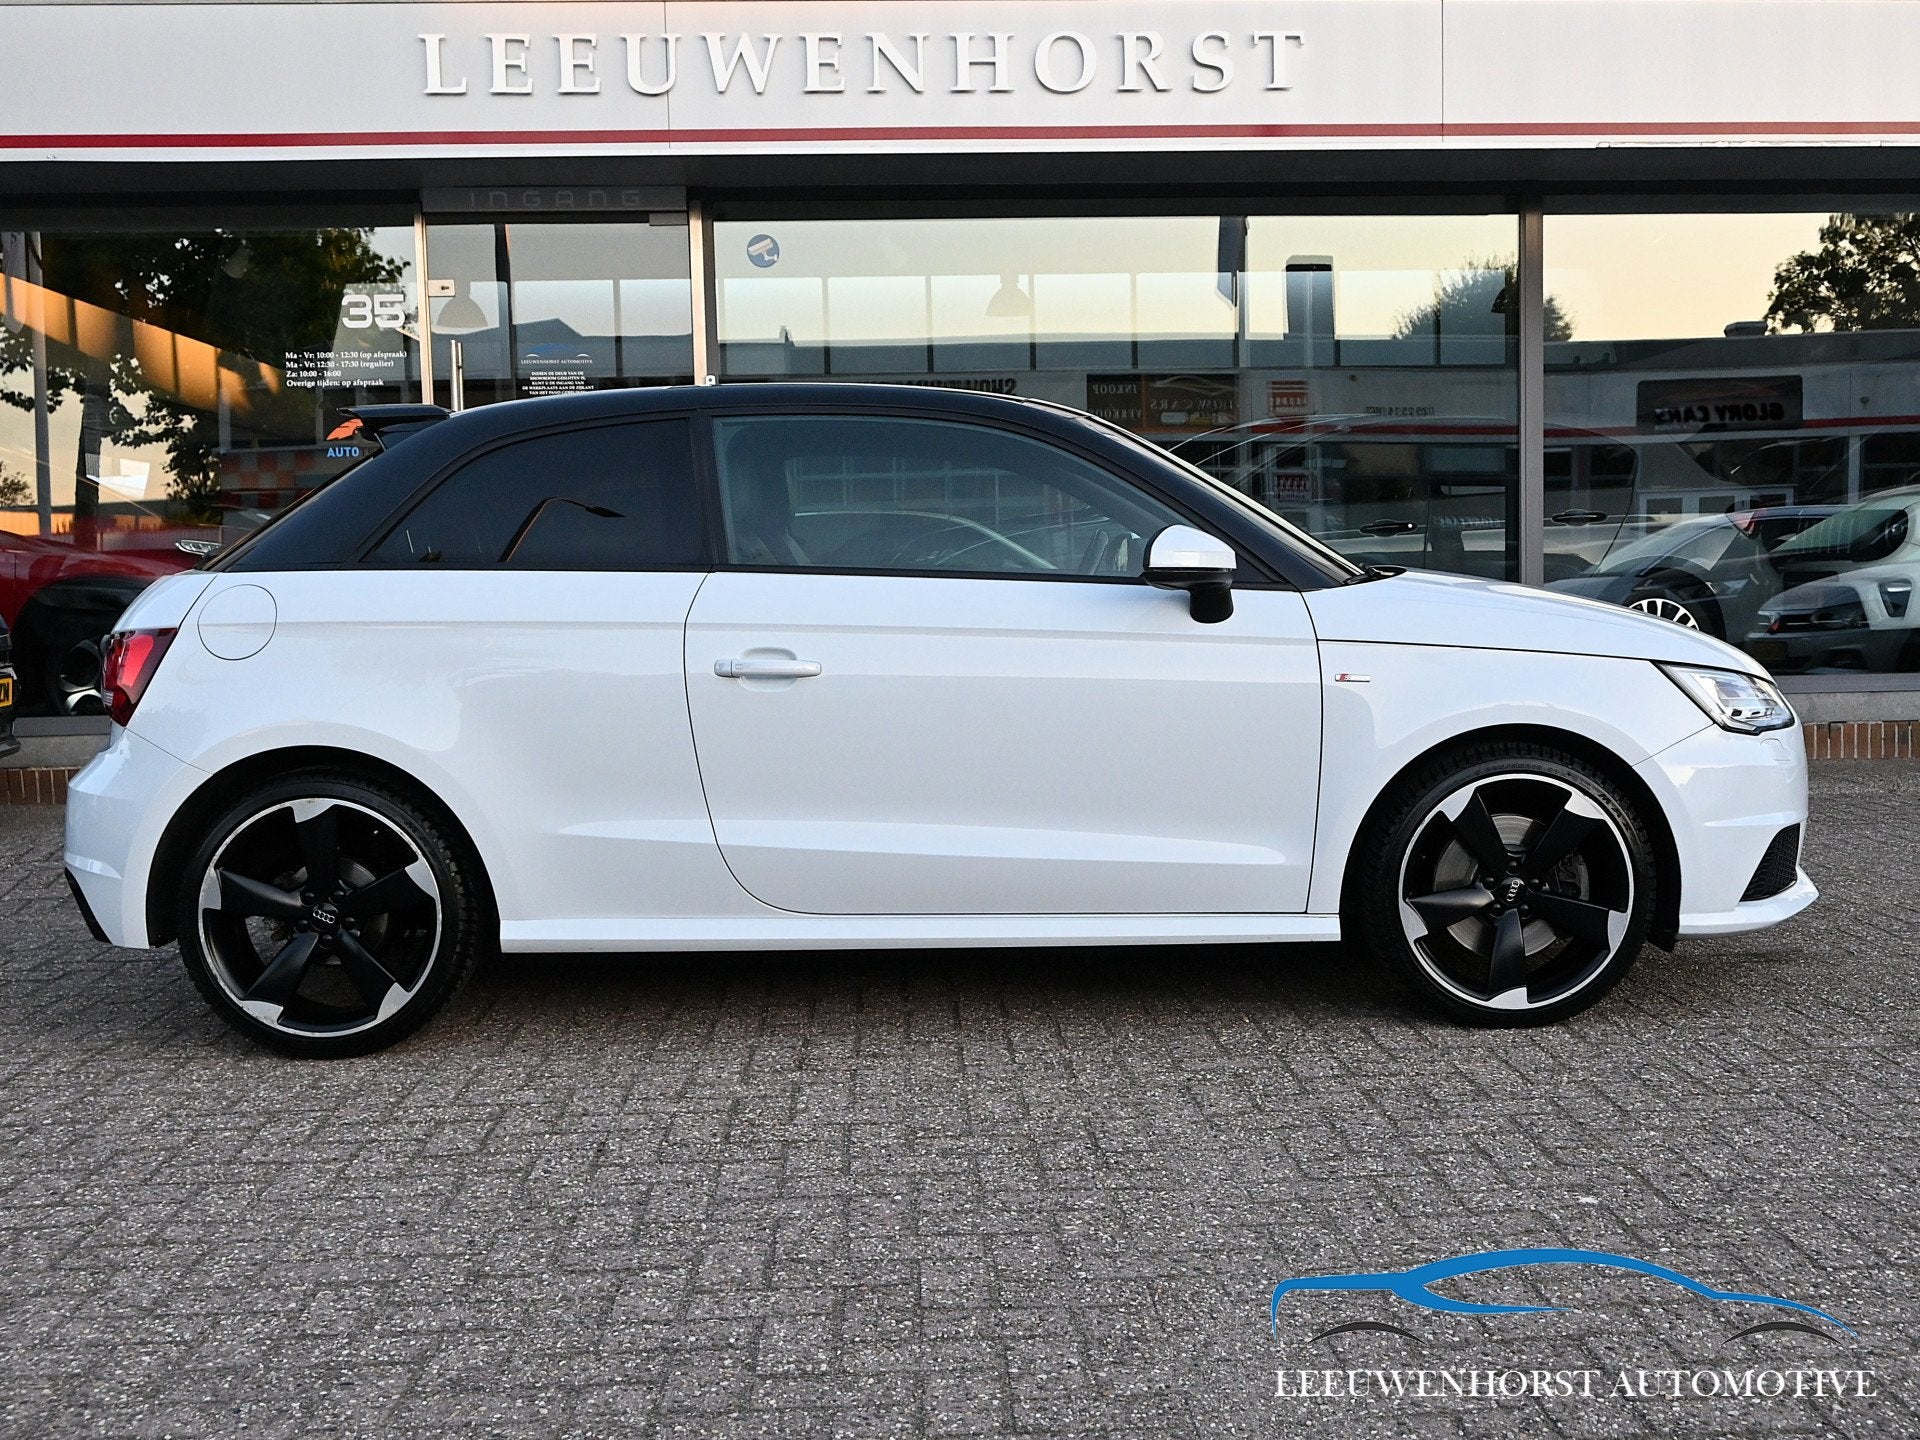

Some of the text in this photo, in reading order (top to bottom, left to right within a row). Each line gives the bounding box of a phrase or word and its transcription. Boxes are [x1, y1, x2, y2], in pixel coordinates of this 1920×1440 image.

[417, 31, 1304, 96] LEEUWENHORST
[470, 190, 641, 208] INGANG
[341, 294, 406, 328] 35
[360, 351, 372, 360] (op
[373, 350, 408, 360] afspraak)
[360, 360, 395, 370] (regulier)
[286, 379, 316, 389] Overige
[316, 379, 341, 388] tijden:
[352, 378, 385, 388] afspraak
[326, 446, 360, 458] AUTO
